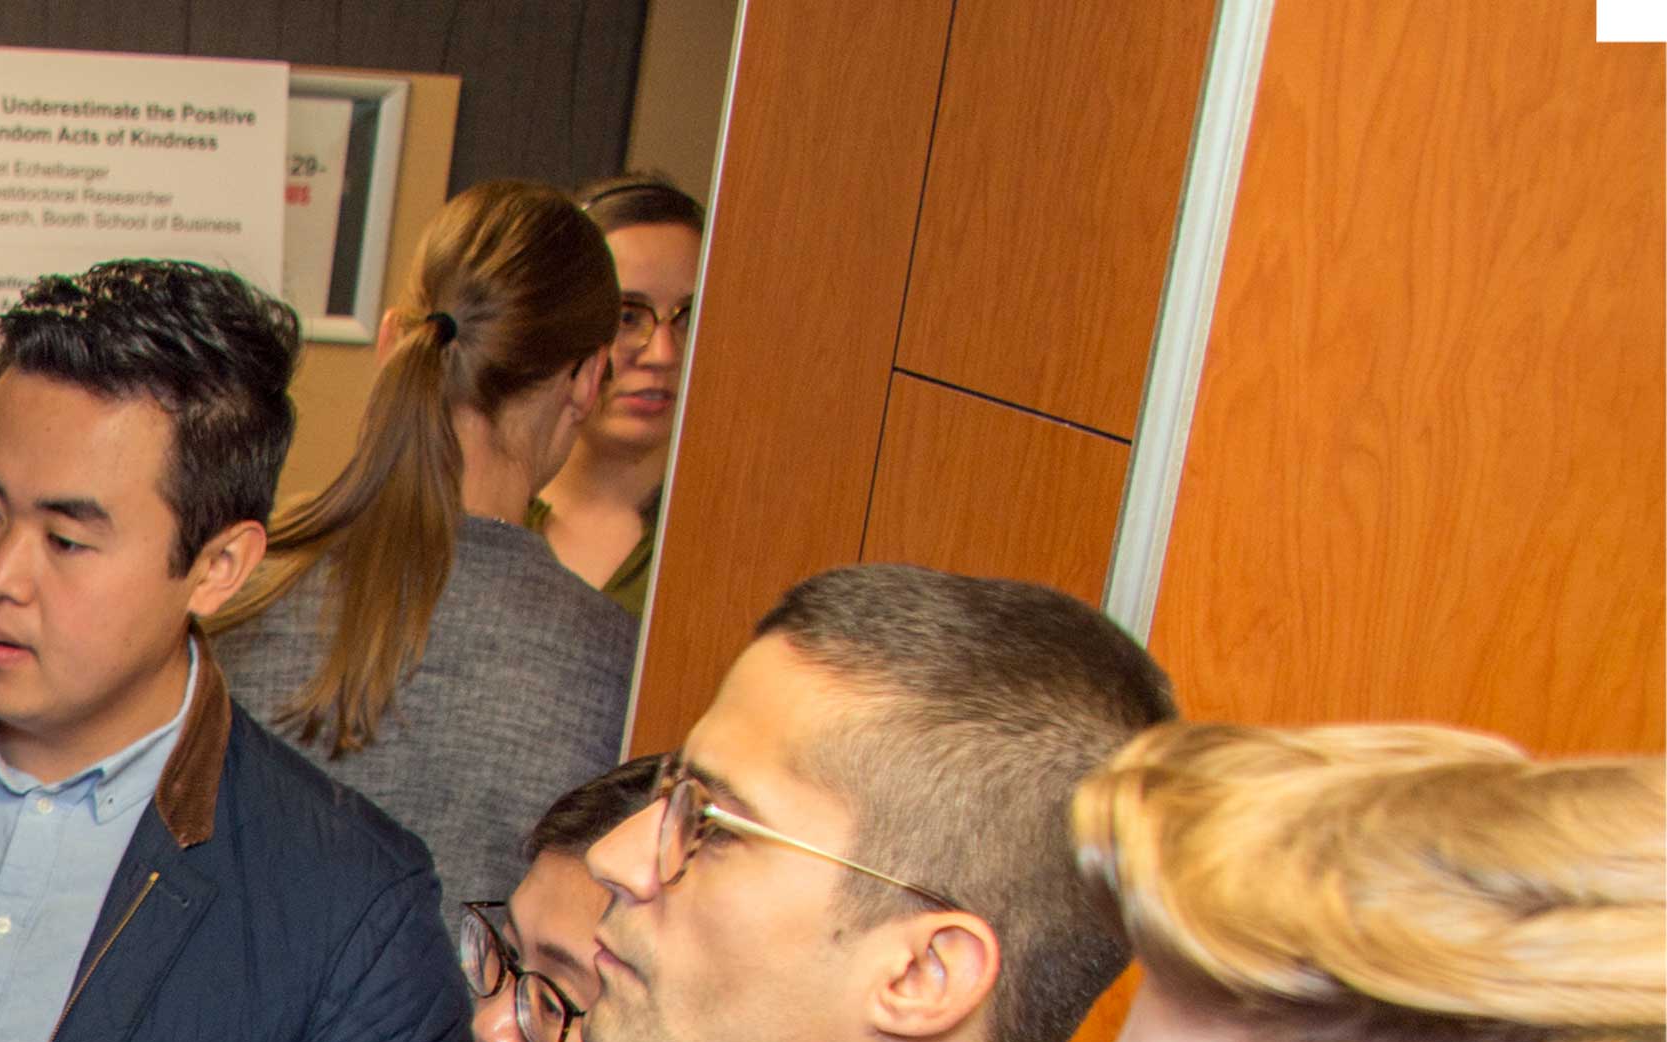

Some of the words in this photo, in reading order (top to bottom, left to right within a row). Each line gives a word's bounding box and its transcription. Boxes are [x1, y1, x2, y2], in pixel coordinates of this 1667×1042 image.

[2, 96, 140, 120] Underestimate
[146, 102, 175, 120] the
[181, 103, 256, 126] Positive
[58, 127, 100, 145] Acts
[106, 128, 125, 146] of
[130, 130, 218, 151] Kindness
